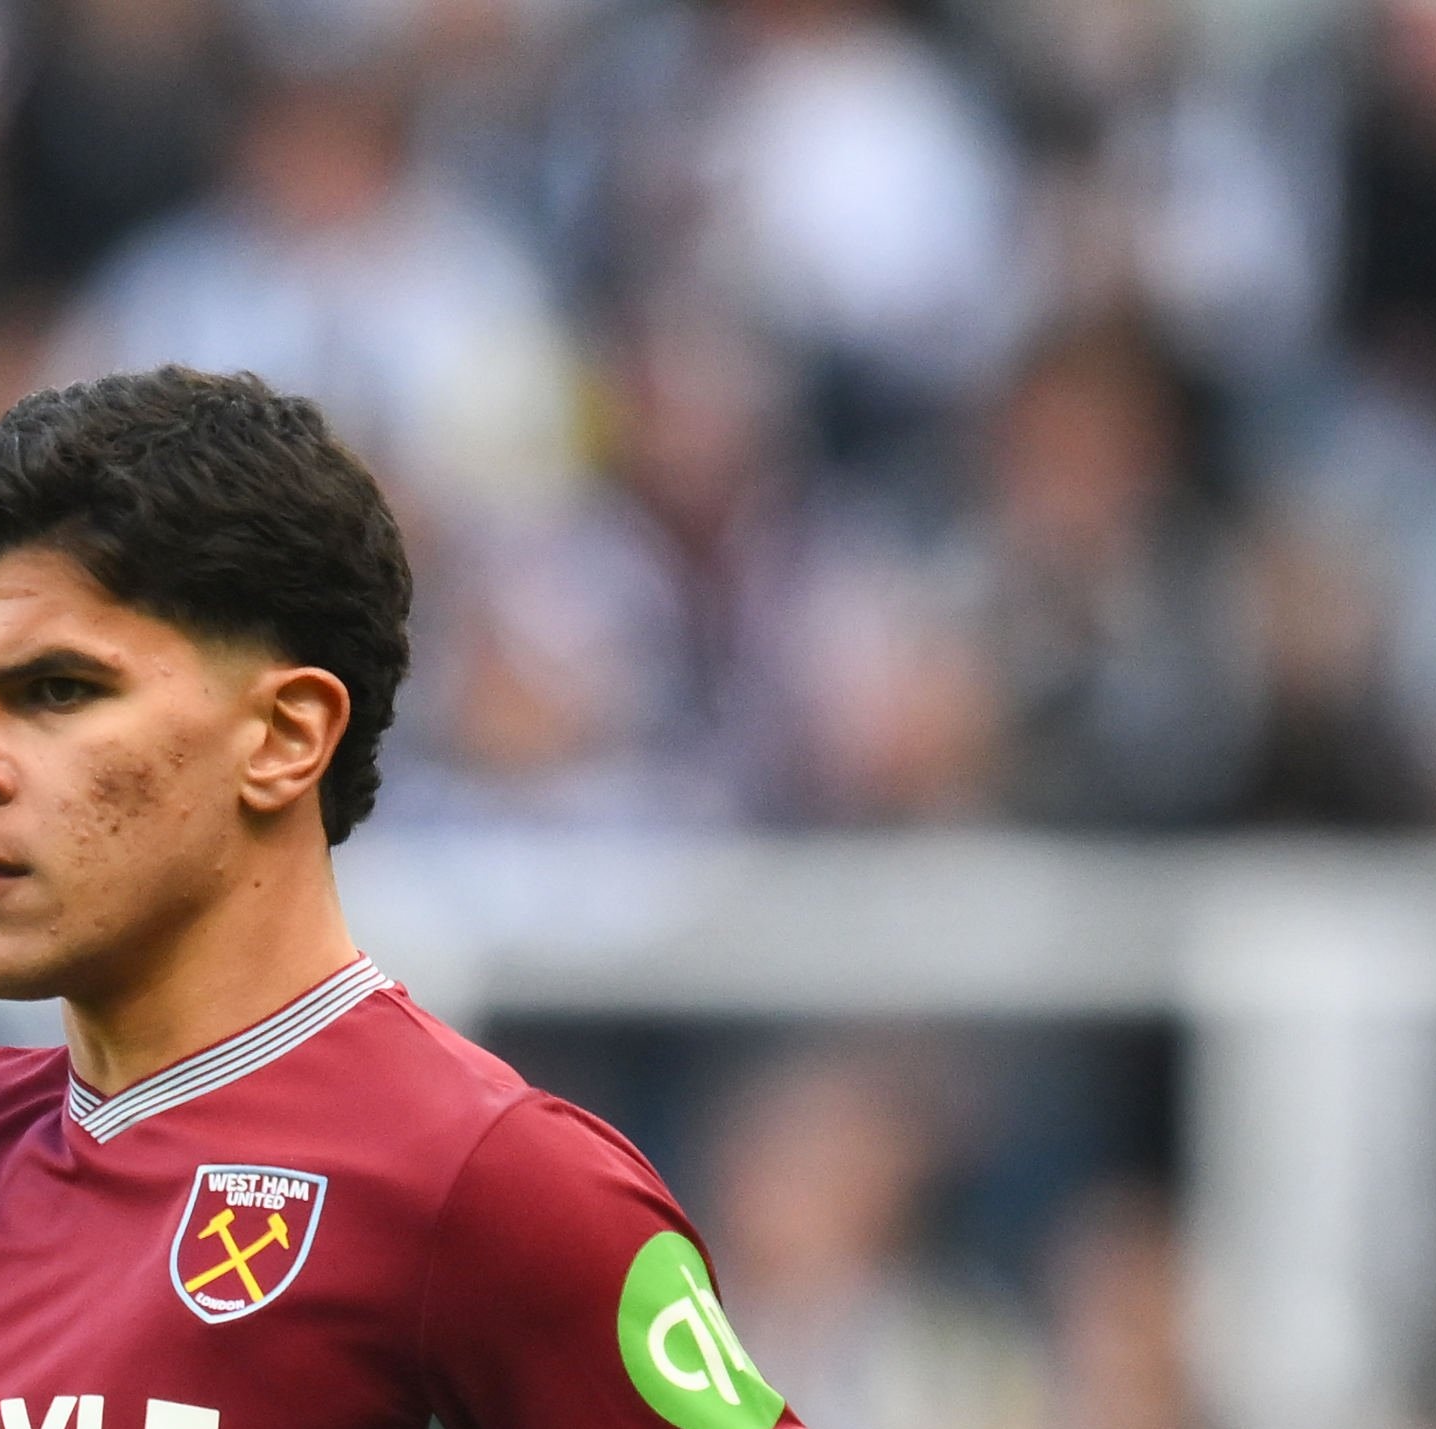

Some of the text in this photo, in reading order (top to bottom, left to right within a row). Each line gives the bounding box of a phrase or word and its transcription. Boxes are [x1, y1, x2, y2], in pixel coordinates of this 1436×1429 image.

[208, 1173, 310, 1202] WEST HAM
[225, 1191, 286, 1210] UNITED
[194, 1291, 246, 1311] LONDON
